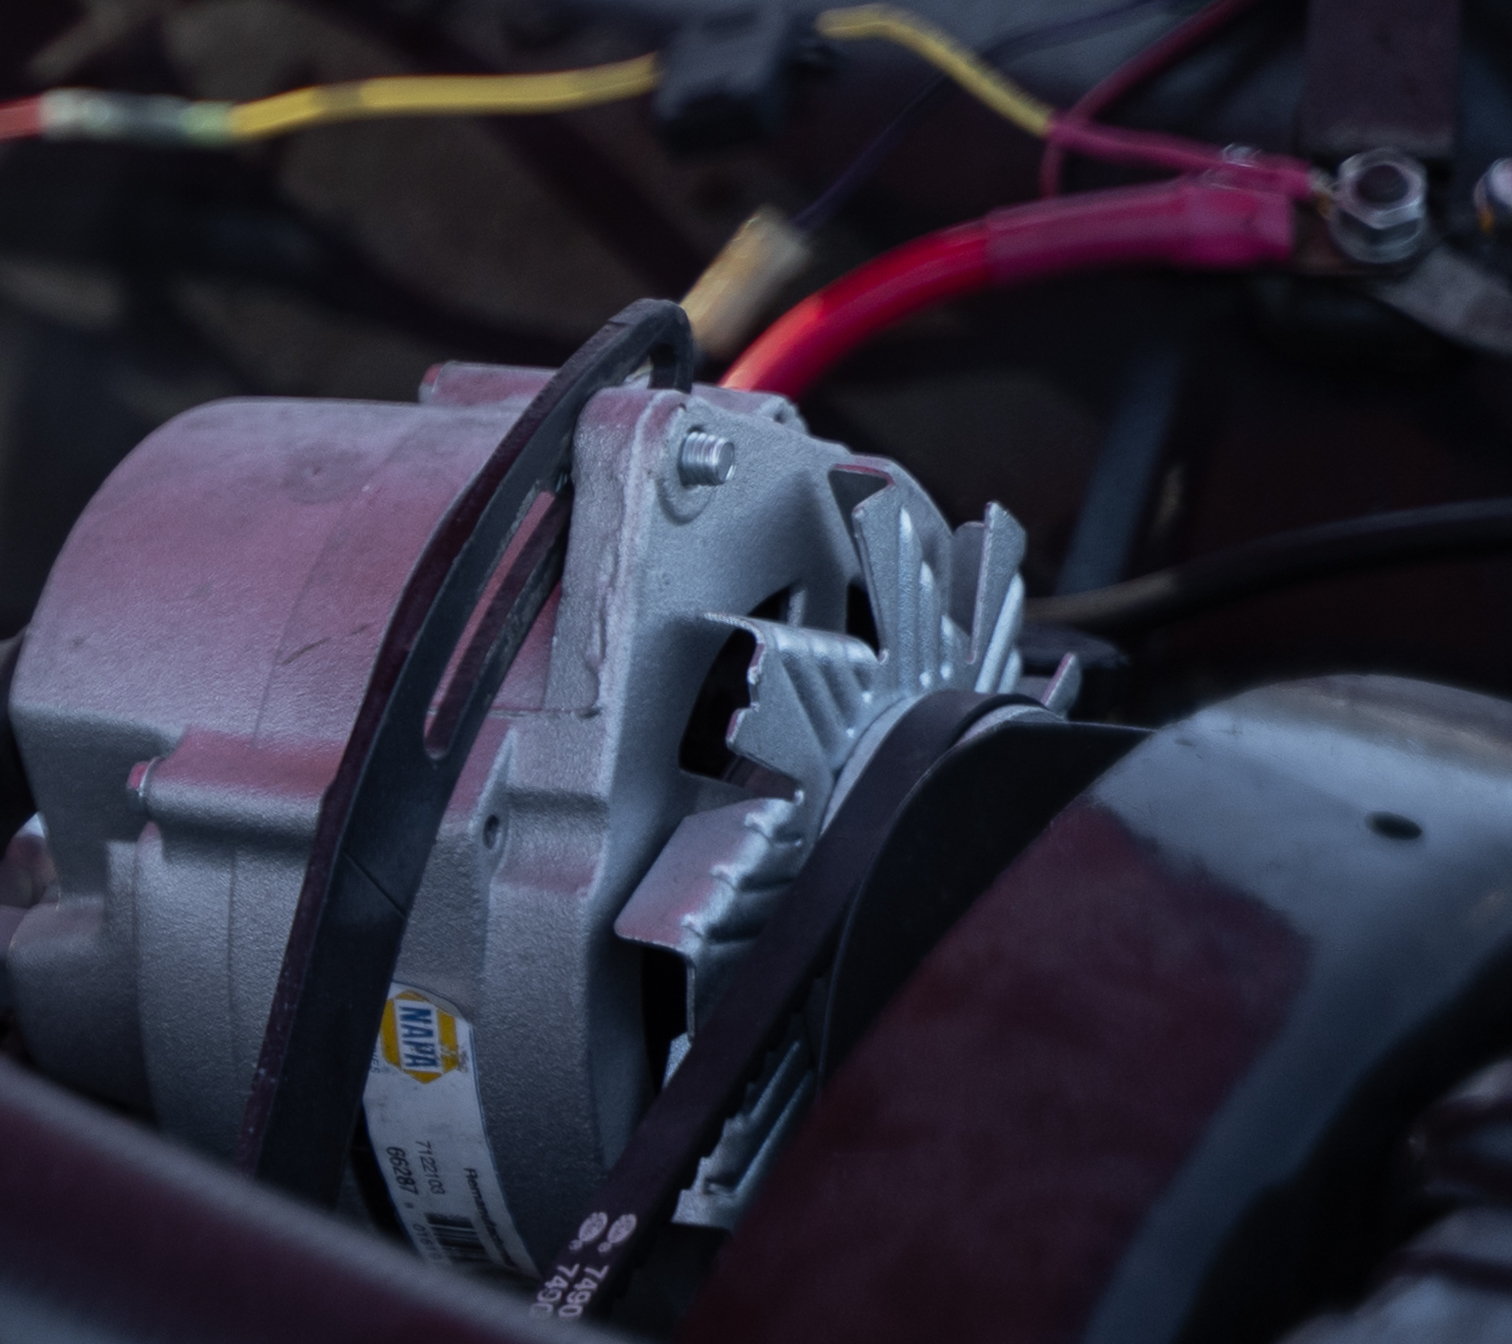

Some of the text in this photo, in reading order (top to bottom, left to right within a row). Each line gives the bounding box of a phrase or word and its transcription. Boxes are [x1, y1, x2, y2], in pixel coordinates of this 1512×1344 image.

[398, 1005, 438, 1067] NAPA
[386, 1145, 419, 1196] 66287
[415, 1140, 446, 1195] 7122103
[557, 1264, 609, 1317] 7490
